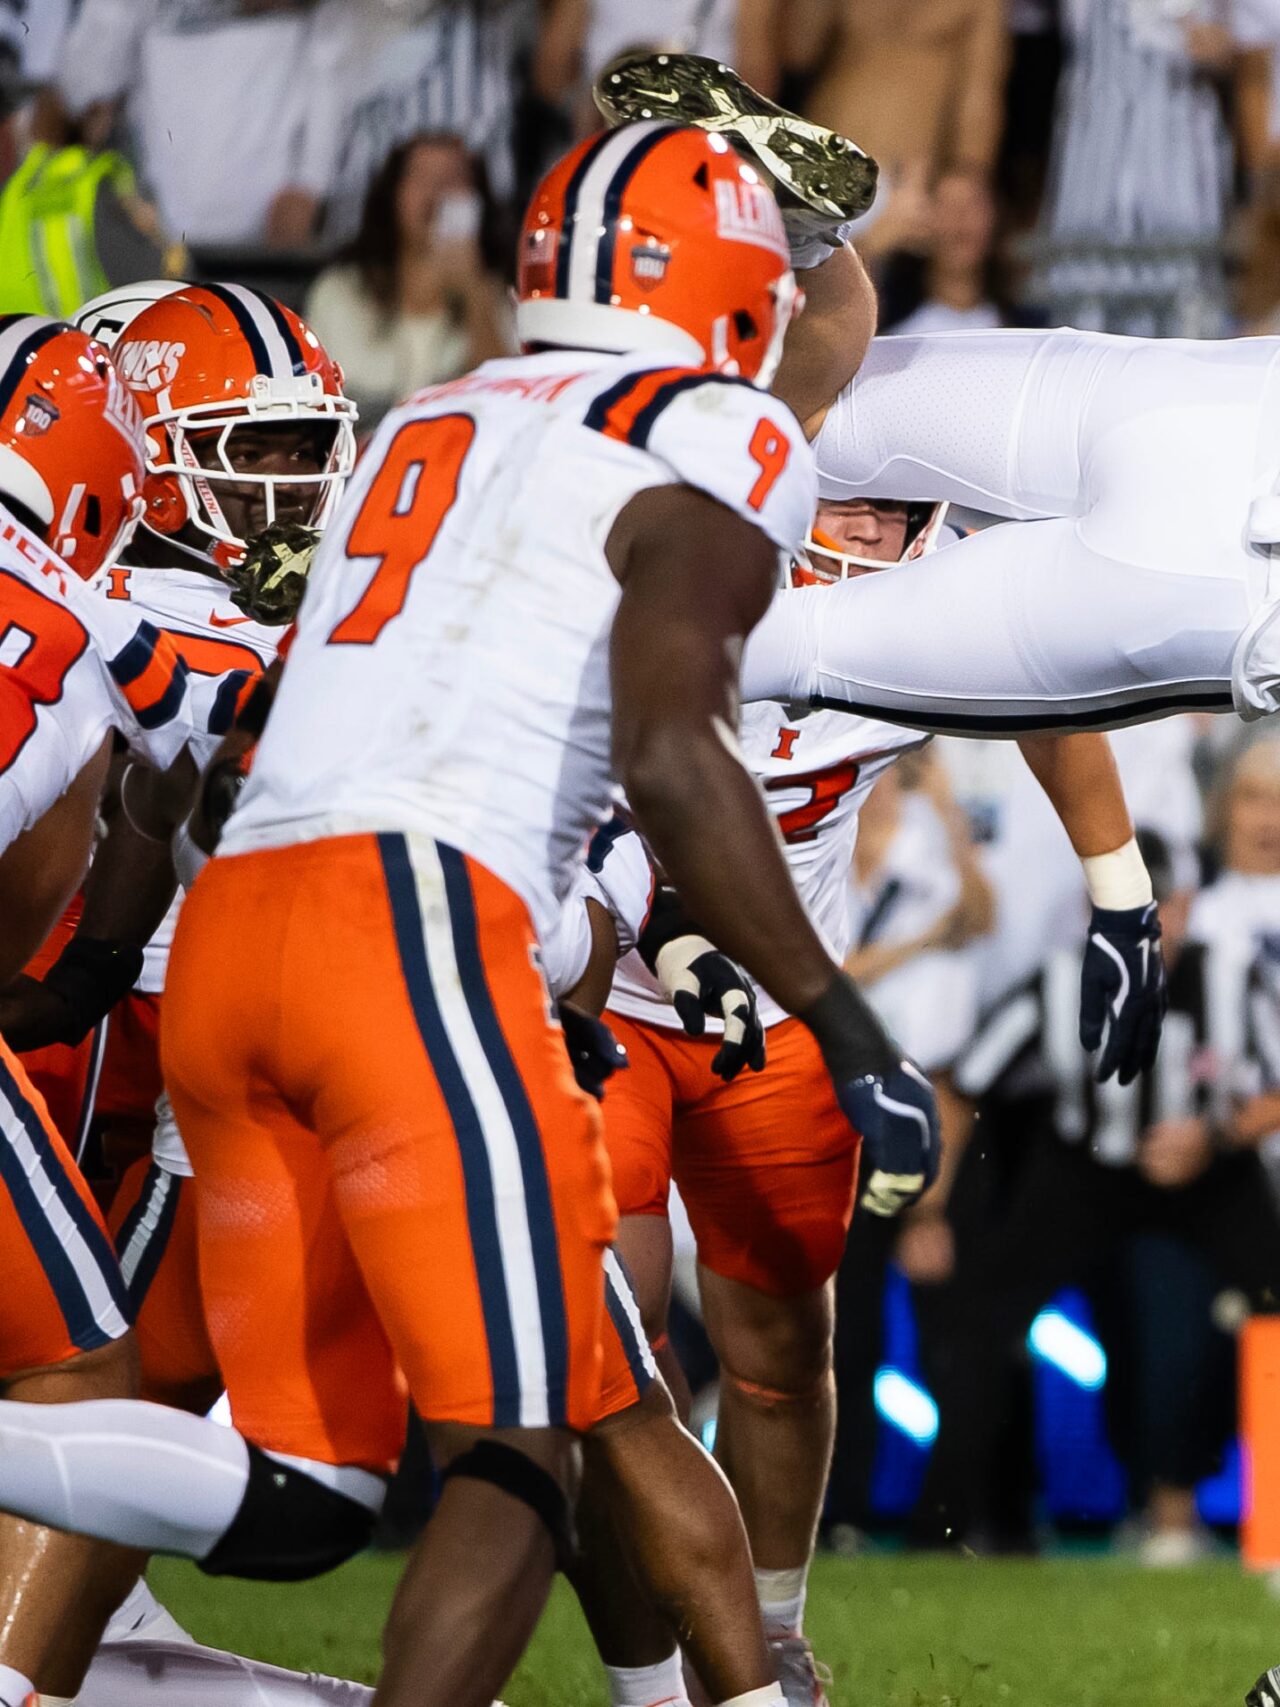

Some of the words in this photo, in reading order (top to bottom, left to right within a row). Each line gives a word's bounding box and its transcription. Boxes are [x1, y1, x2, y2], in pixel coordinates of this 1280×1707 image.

[25, 403, 51, 429] 100
[747, 416, 791, 512] 9
[326, 411, 477, 646] 9
[105, 567, 133, 601] I
[770, 727, 801, 761] I
